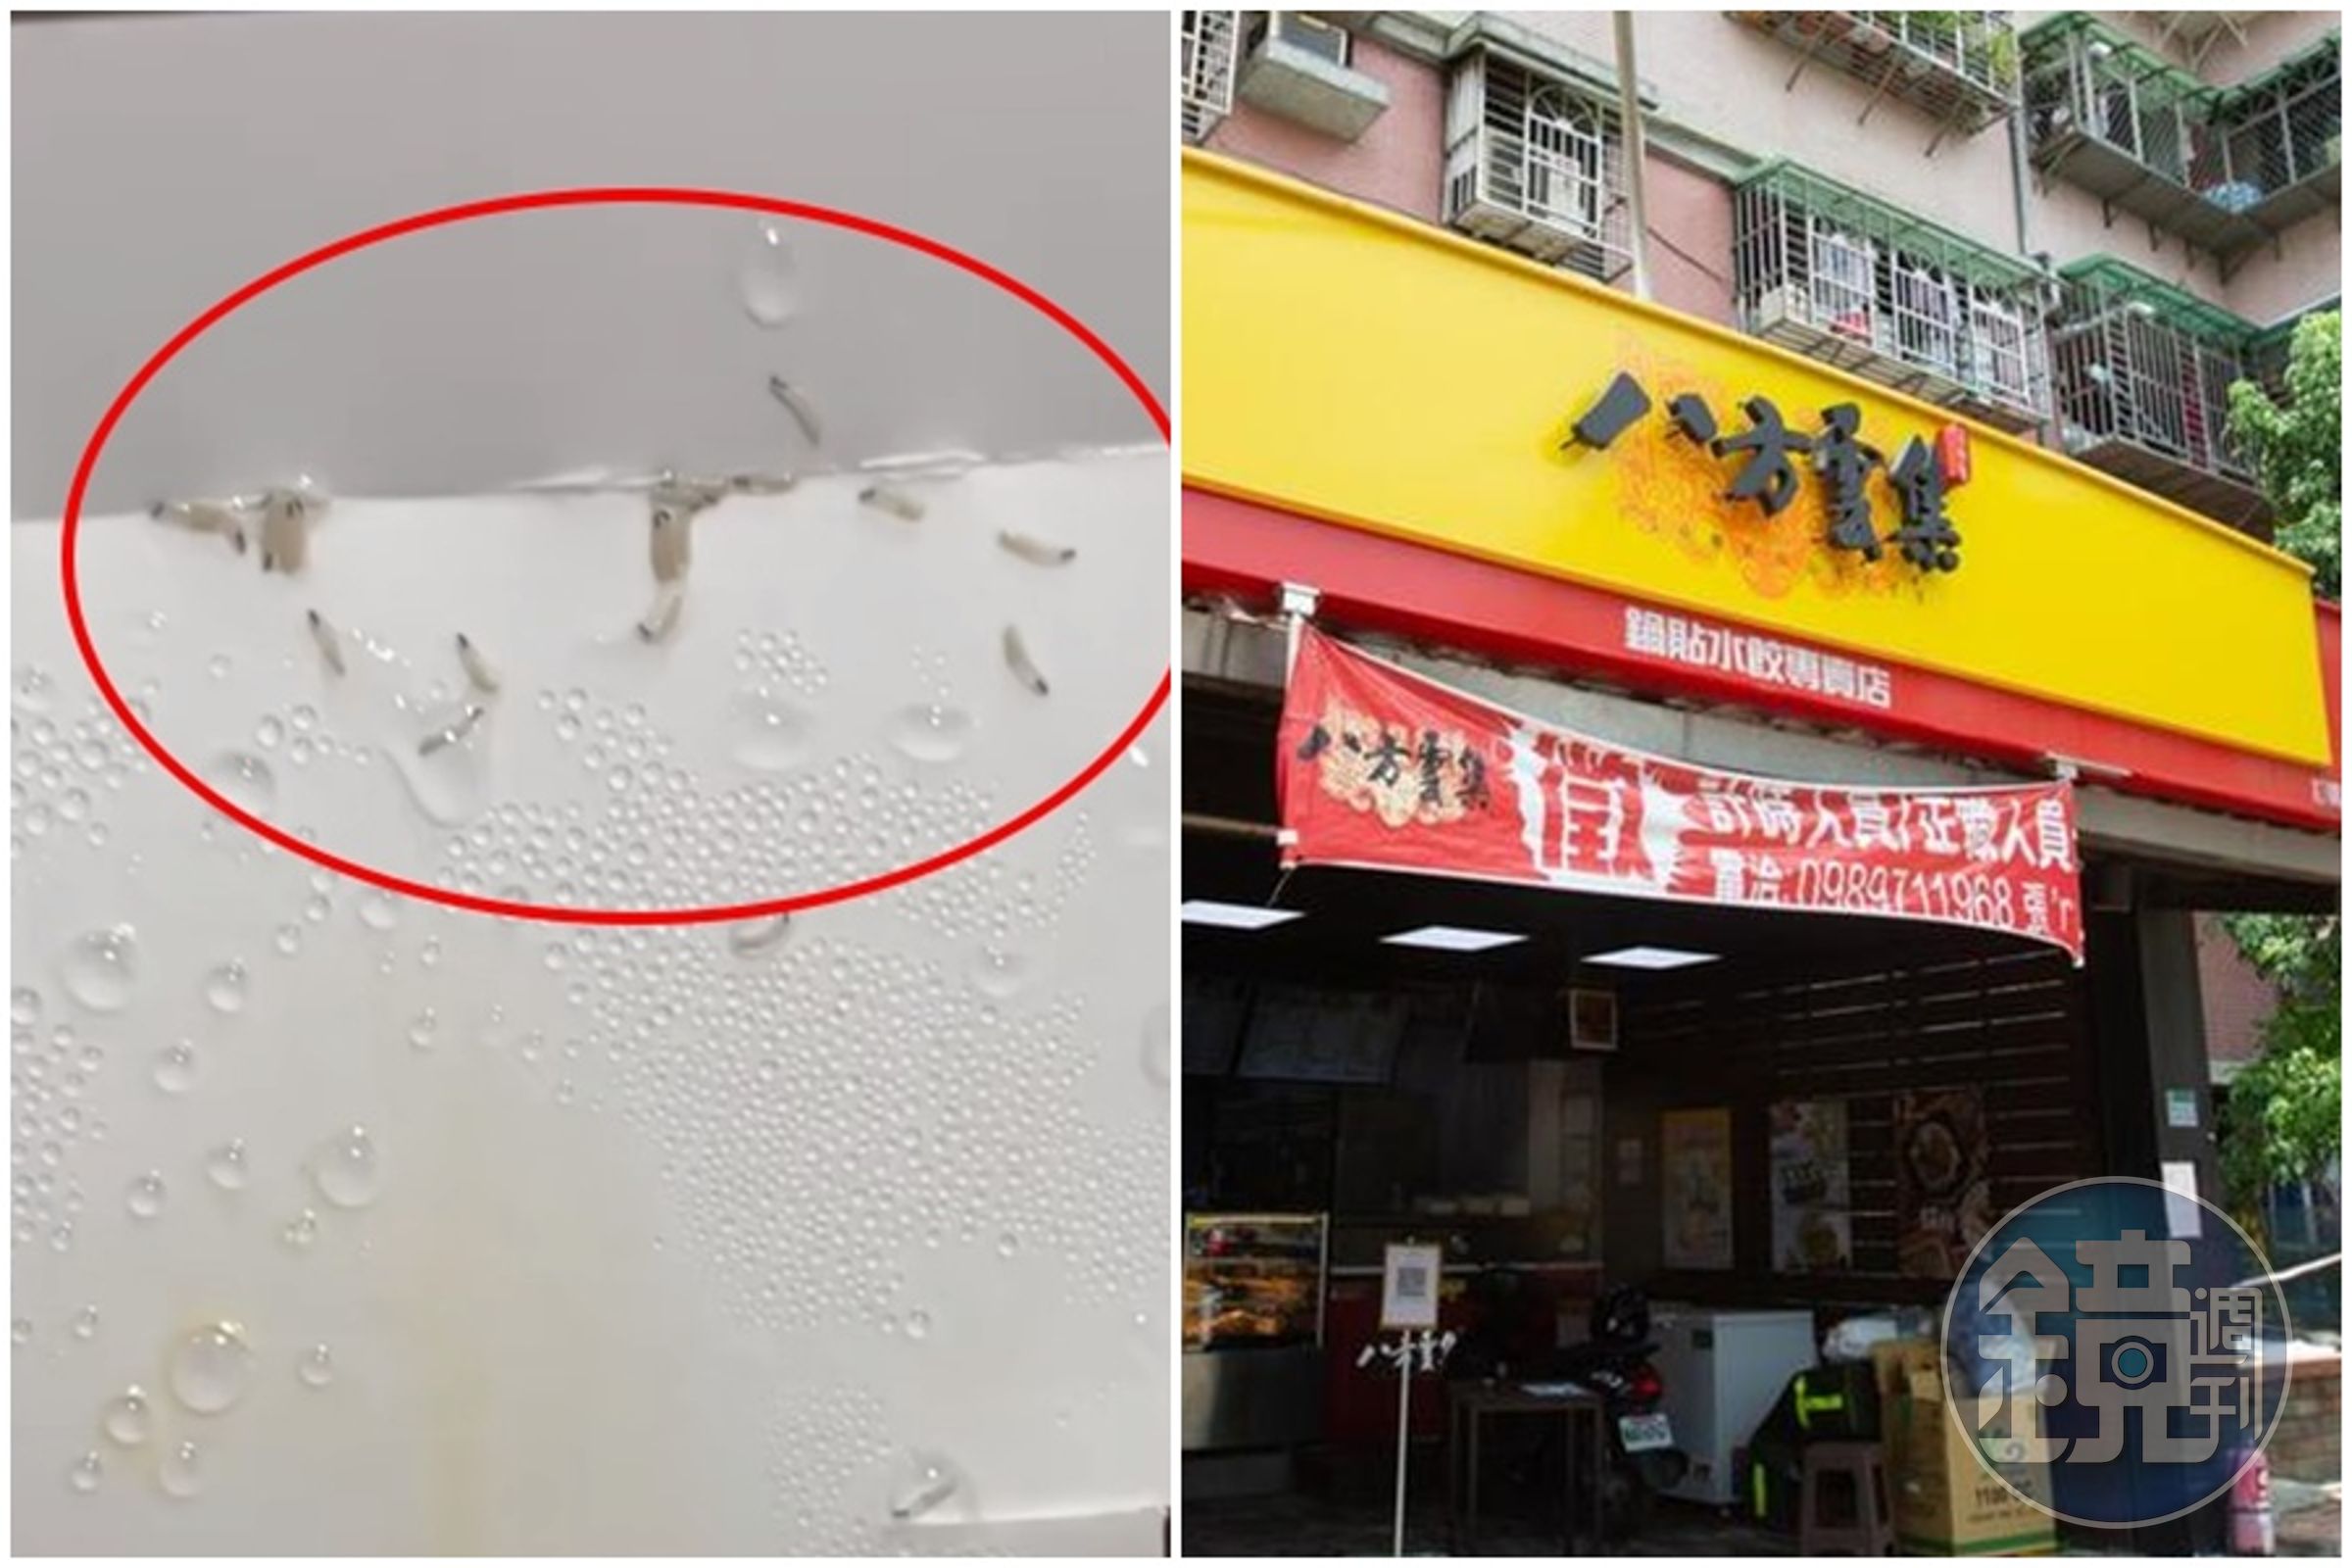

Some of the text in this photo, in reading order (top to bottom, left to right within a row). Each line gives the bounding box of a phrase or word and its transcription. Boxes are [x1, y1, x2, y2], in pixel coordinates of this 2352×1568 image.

[1571, 370, 1960, 574] 八方雲集
[1623, 605, 1891, 709] 鍋貼水餃專賣店
[1297, 726, 1491, 812] 八方雲集
